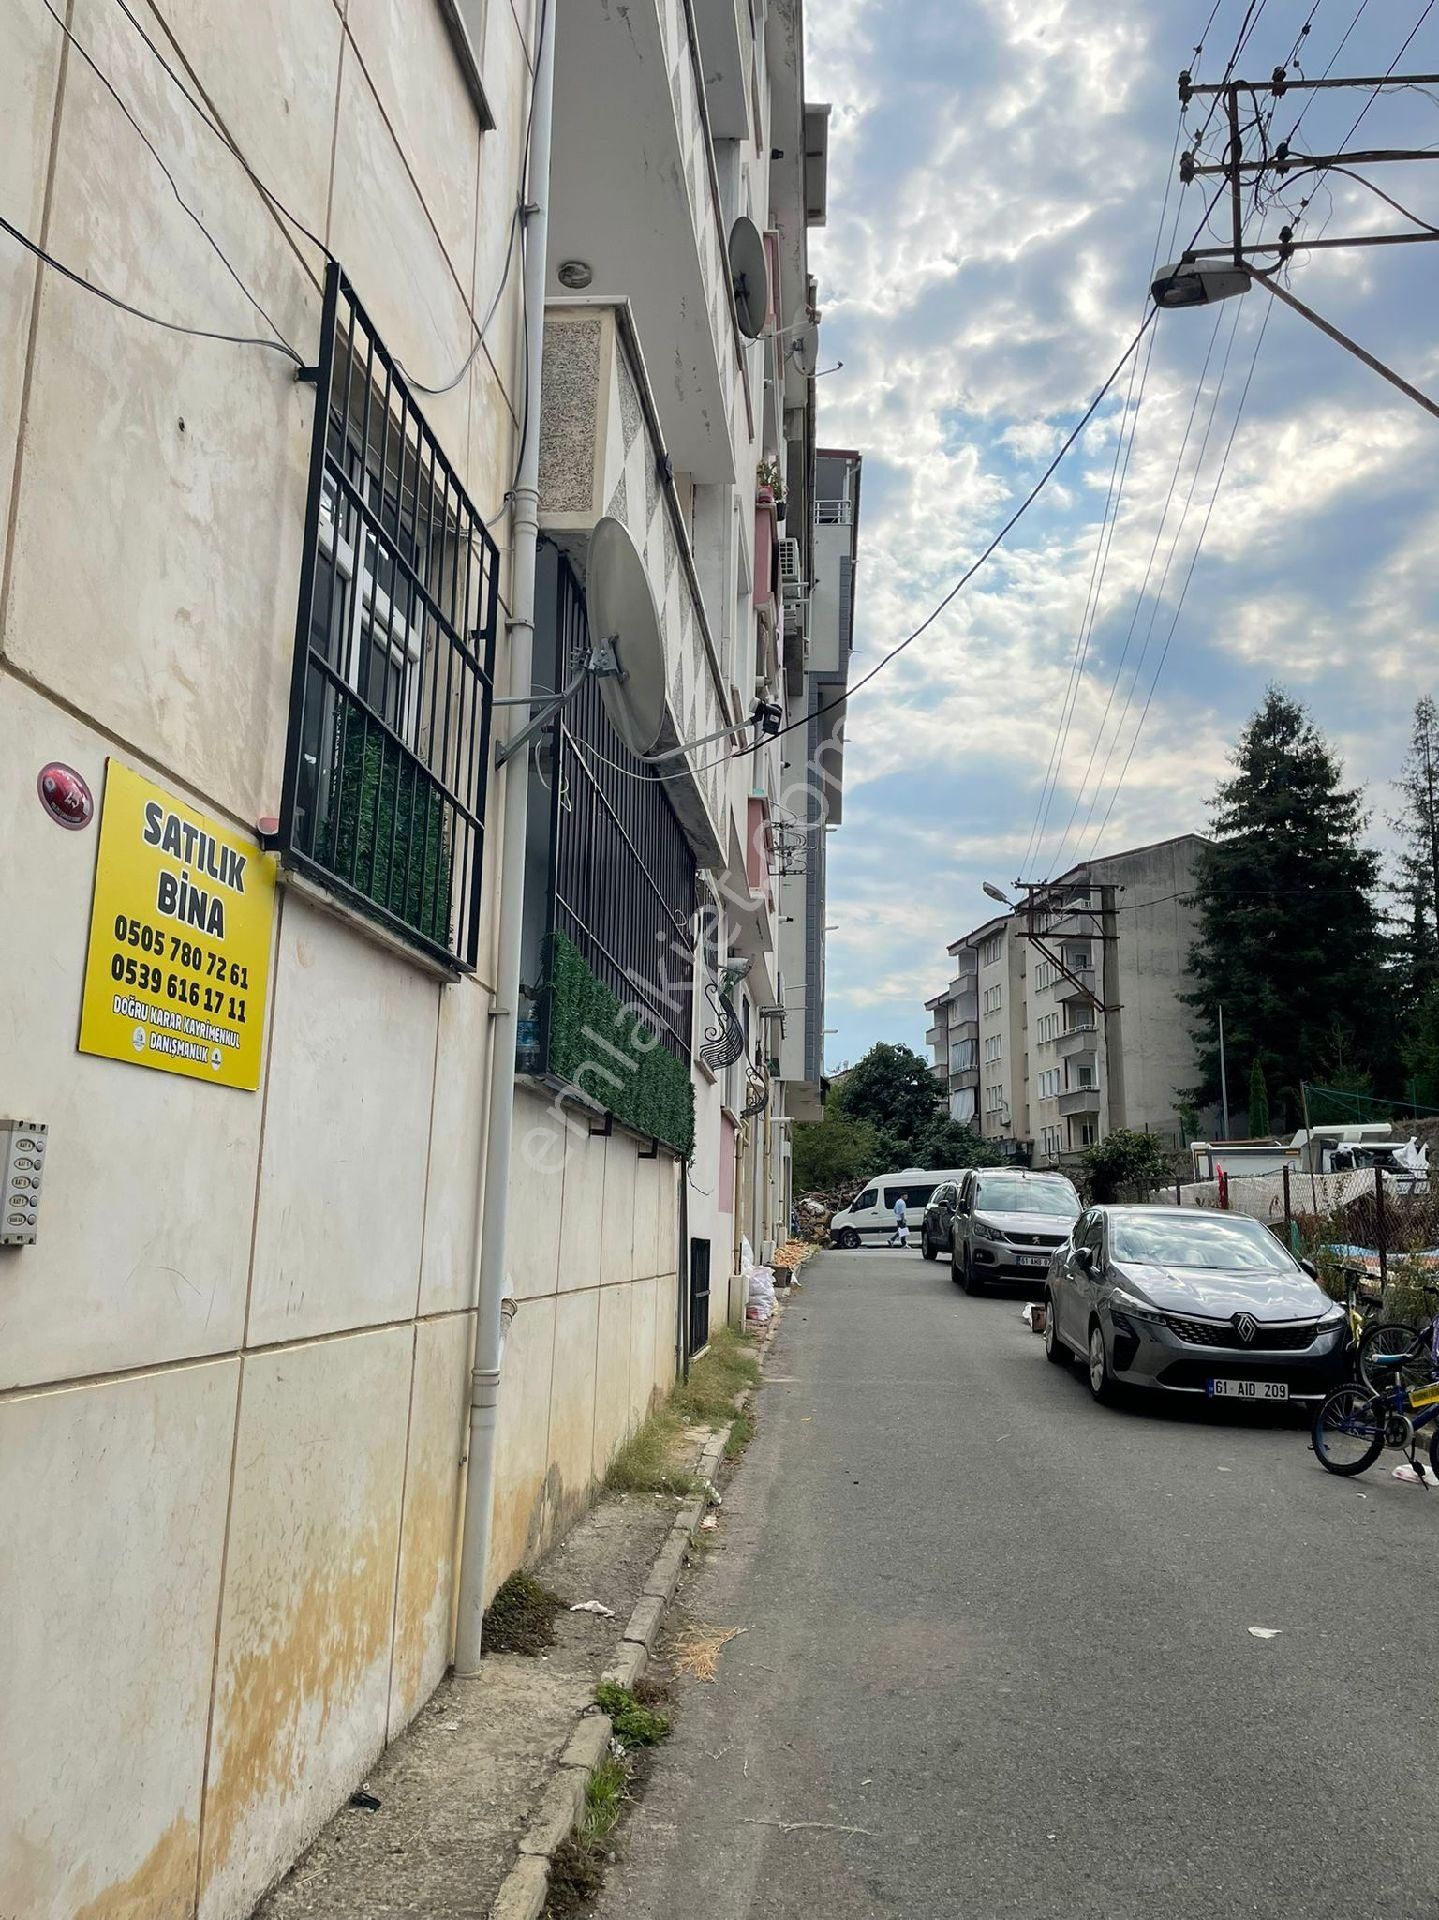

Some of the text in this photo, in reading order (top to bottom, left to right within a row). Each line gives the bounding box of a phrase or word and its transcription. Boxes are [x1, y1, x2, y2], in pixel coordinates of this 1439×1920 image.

[144, 802, 246, 892] SATILIK
[157, 871, 224, 939] BİNA
[114, 914, 248, 989] 0505 780 72 61
[111, 954, 246, 1022] 0539 616 17 11
[113, 994, 149, 1021] DOĞRU
[150, 1005, 182, 1031] KARAR
[1216, 1381, 1285, 1398] 61 AID 209
